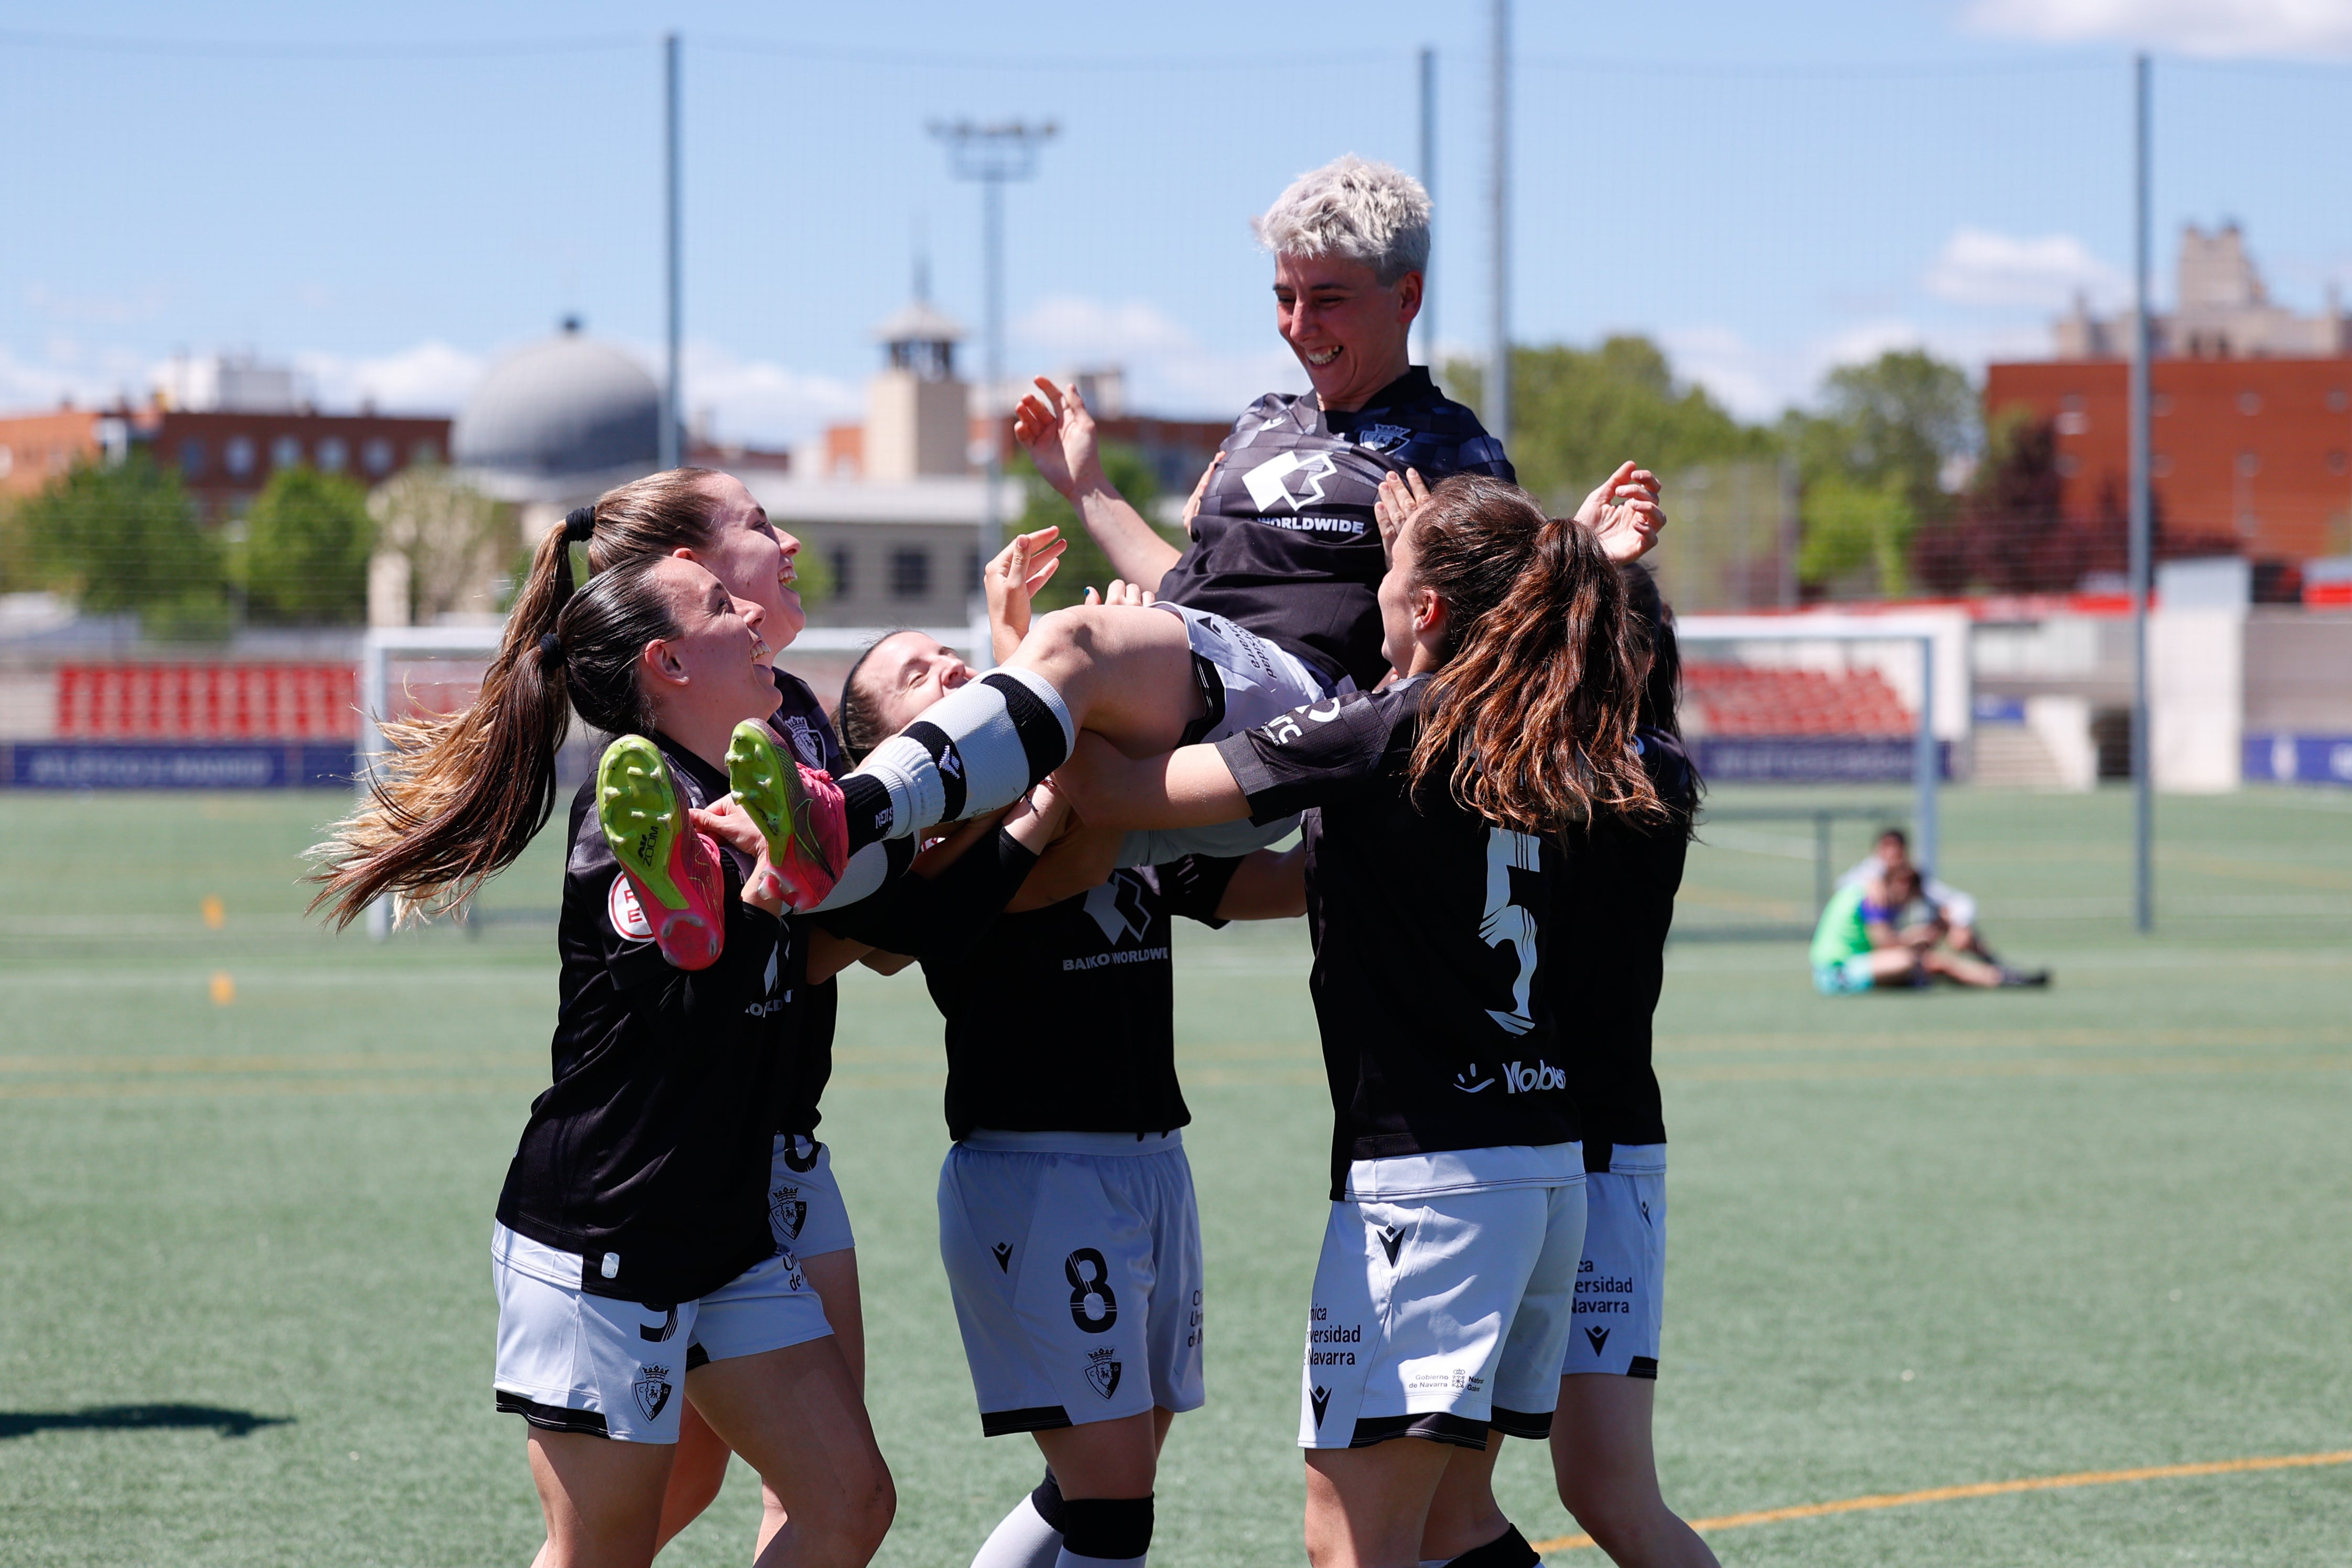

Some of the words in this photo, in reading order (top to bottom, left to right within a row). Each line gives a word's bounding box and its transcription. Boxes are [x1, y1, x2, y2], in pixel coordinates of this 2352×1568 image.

[643, 826, 660, 867] ZOOM
[1479, 826, 1540, 1036] 5
[1062, 953, 1110, 971] BAIKO
[790, 1273, 801, 1291] de
[1065, 1247, 1118, 1334] 8
[1309, 1324, 1361, 1343] versidad
